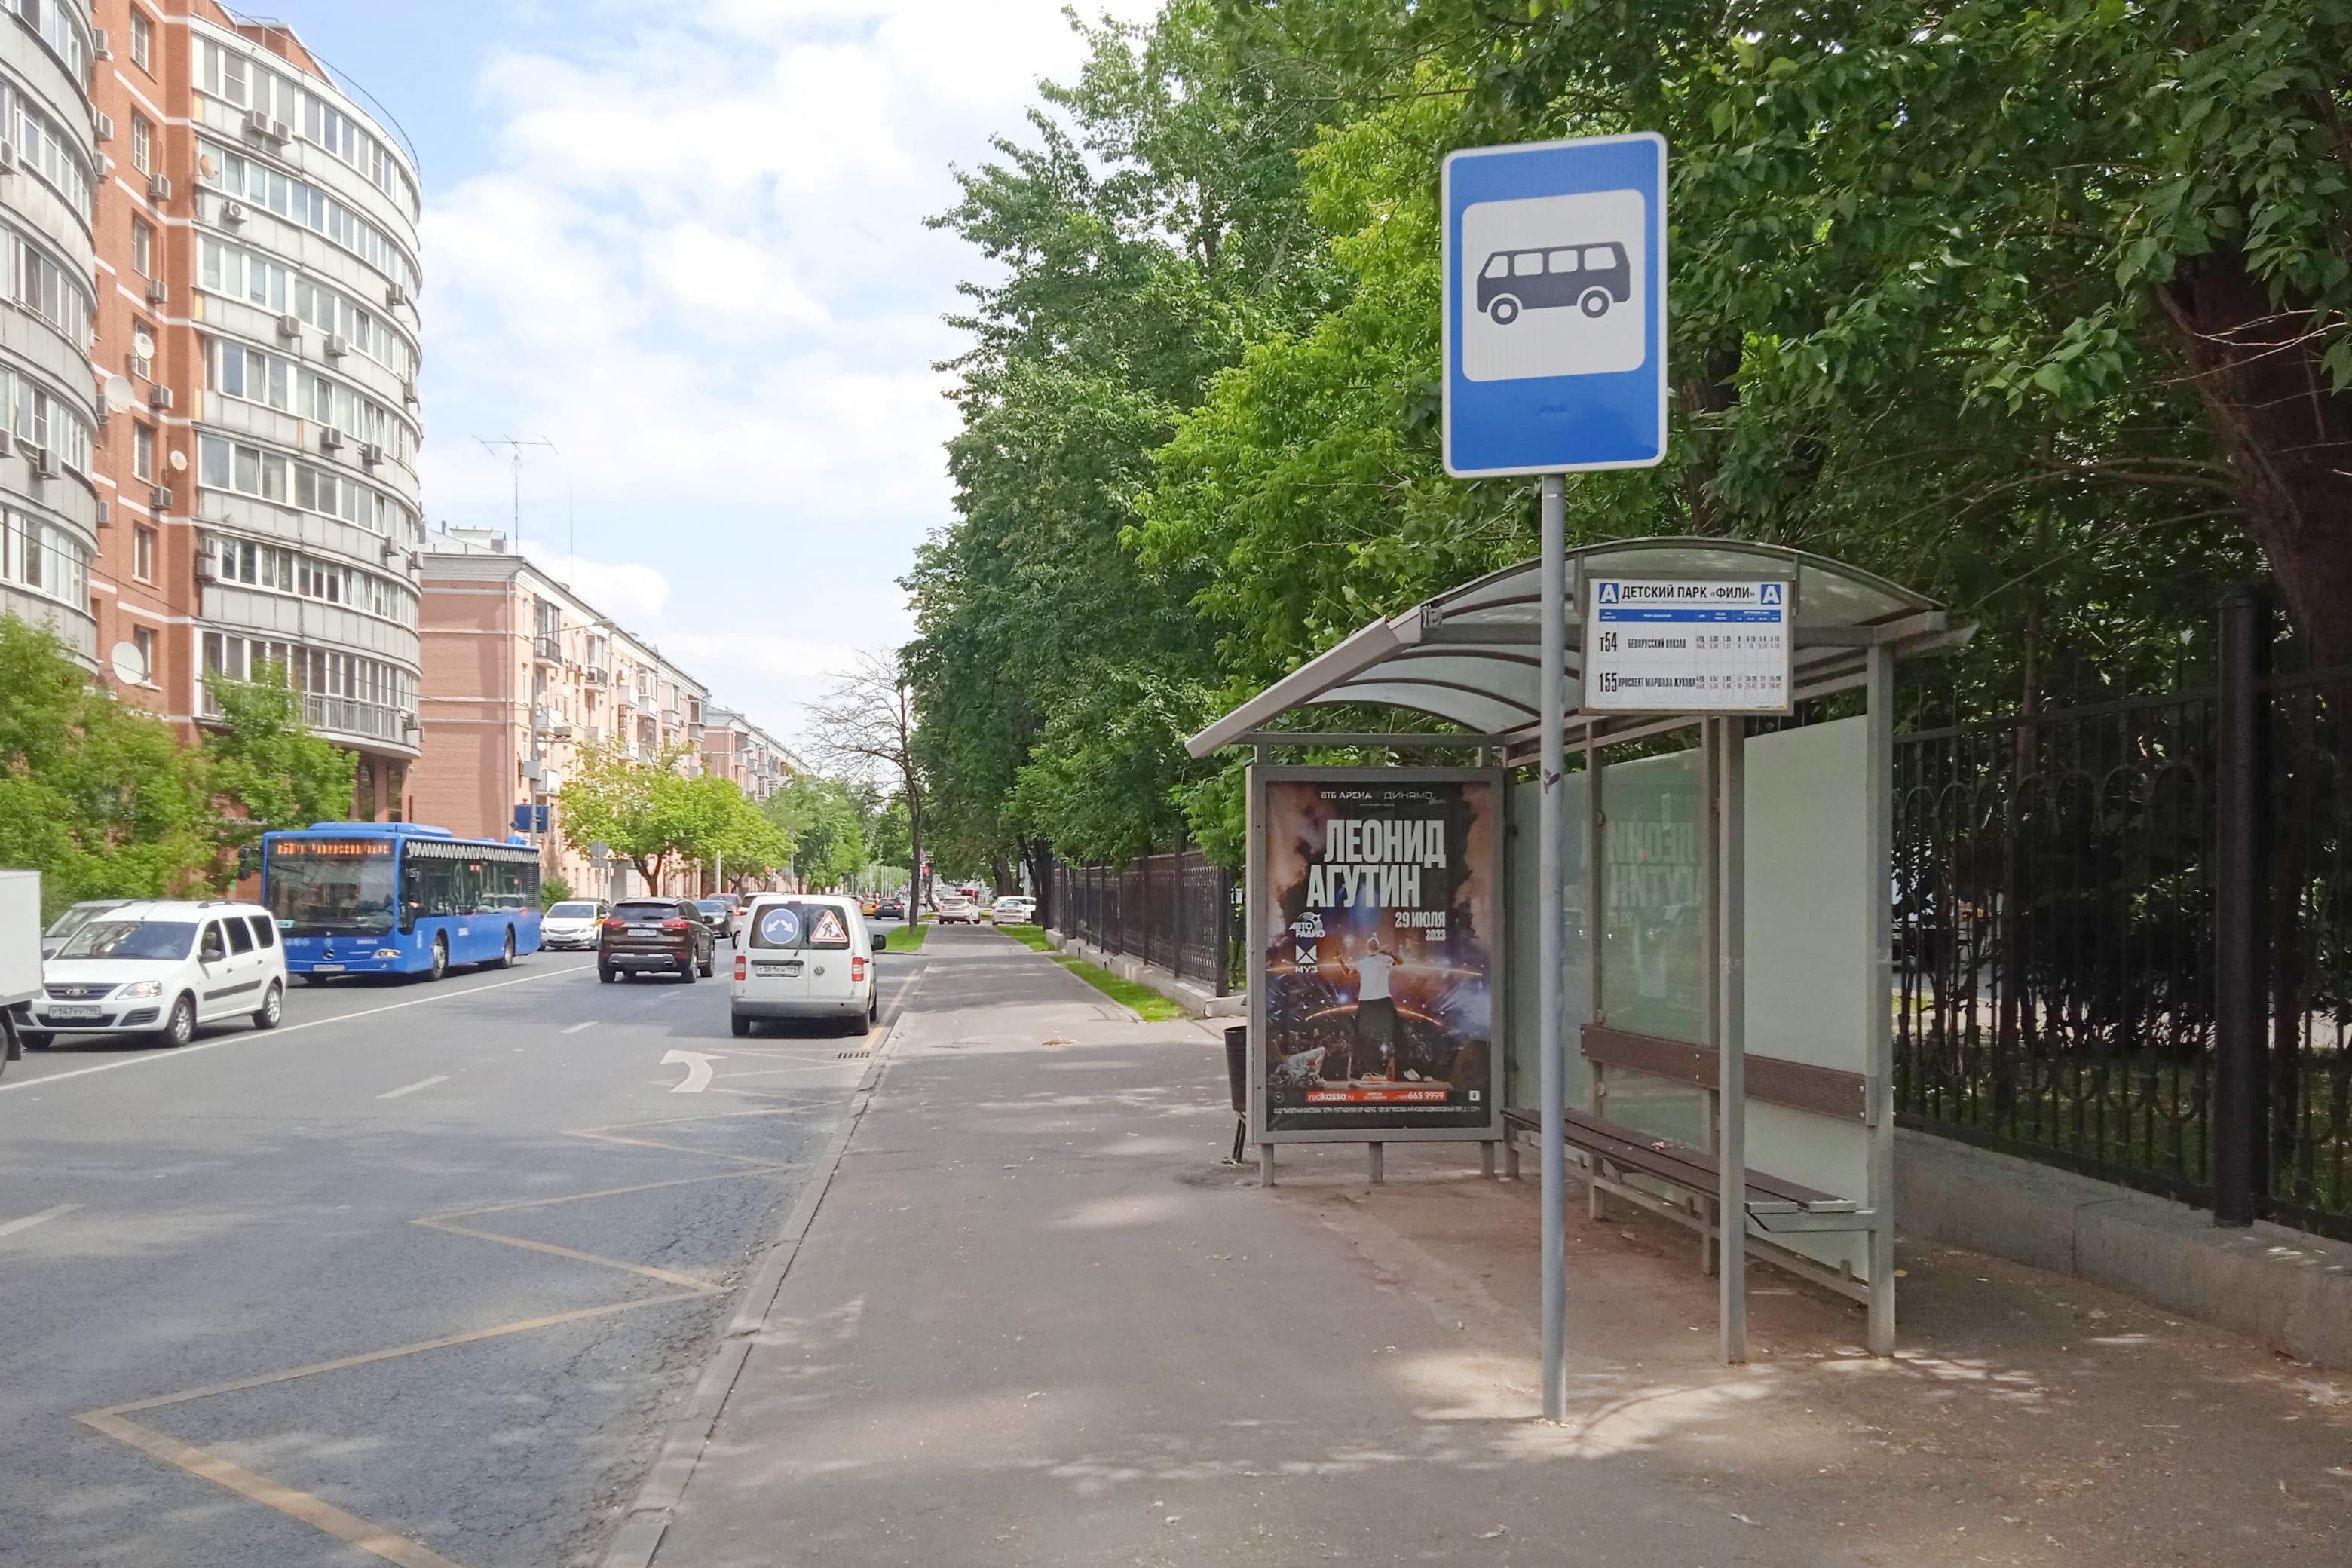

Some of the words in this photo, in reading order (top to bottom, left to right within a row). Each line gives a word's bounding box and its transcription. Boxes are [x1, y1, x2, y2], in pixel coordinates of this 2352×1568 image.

[1622, 584, 1674, 599] ДЕТСКИЙ
[1677, 586, 1707, 598] ПАРК
[1710, 586, 1755, 599] «ФИЛИ»
[1599, 672, 1617, 692] 155
[1324, 819, 1447, 868] ЛЕОНИД
[1306, 865, 1421, 908] АГУТИН
[1395, 911, 1410, 928] 29
[1412, 911, 1446, 928] ИЮЛЯ
[1426, 929, 1446, 941] 2023
